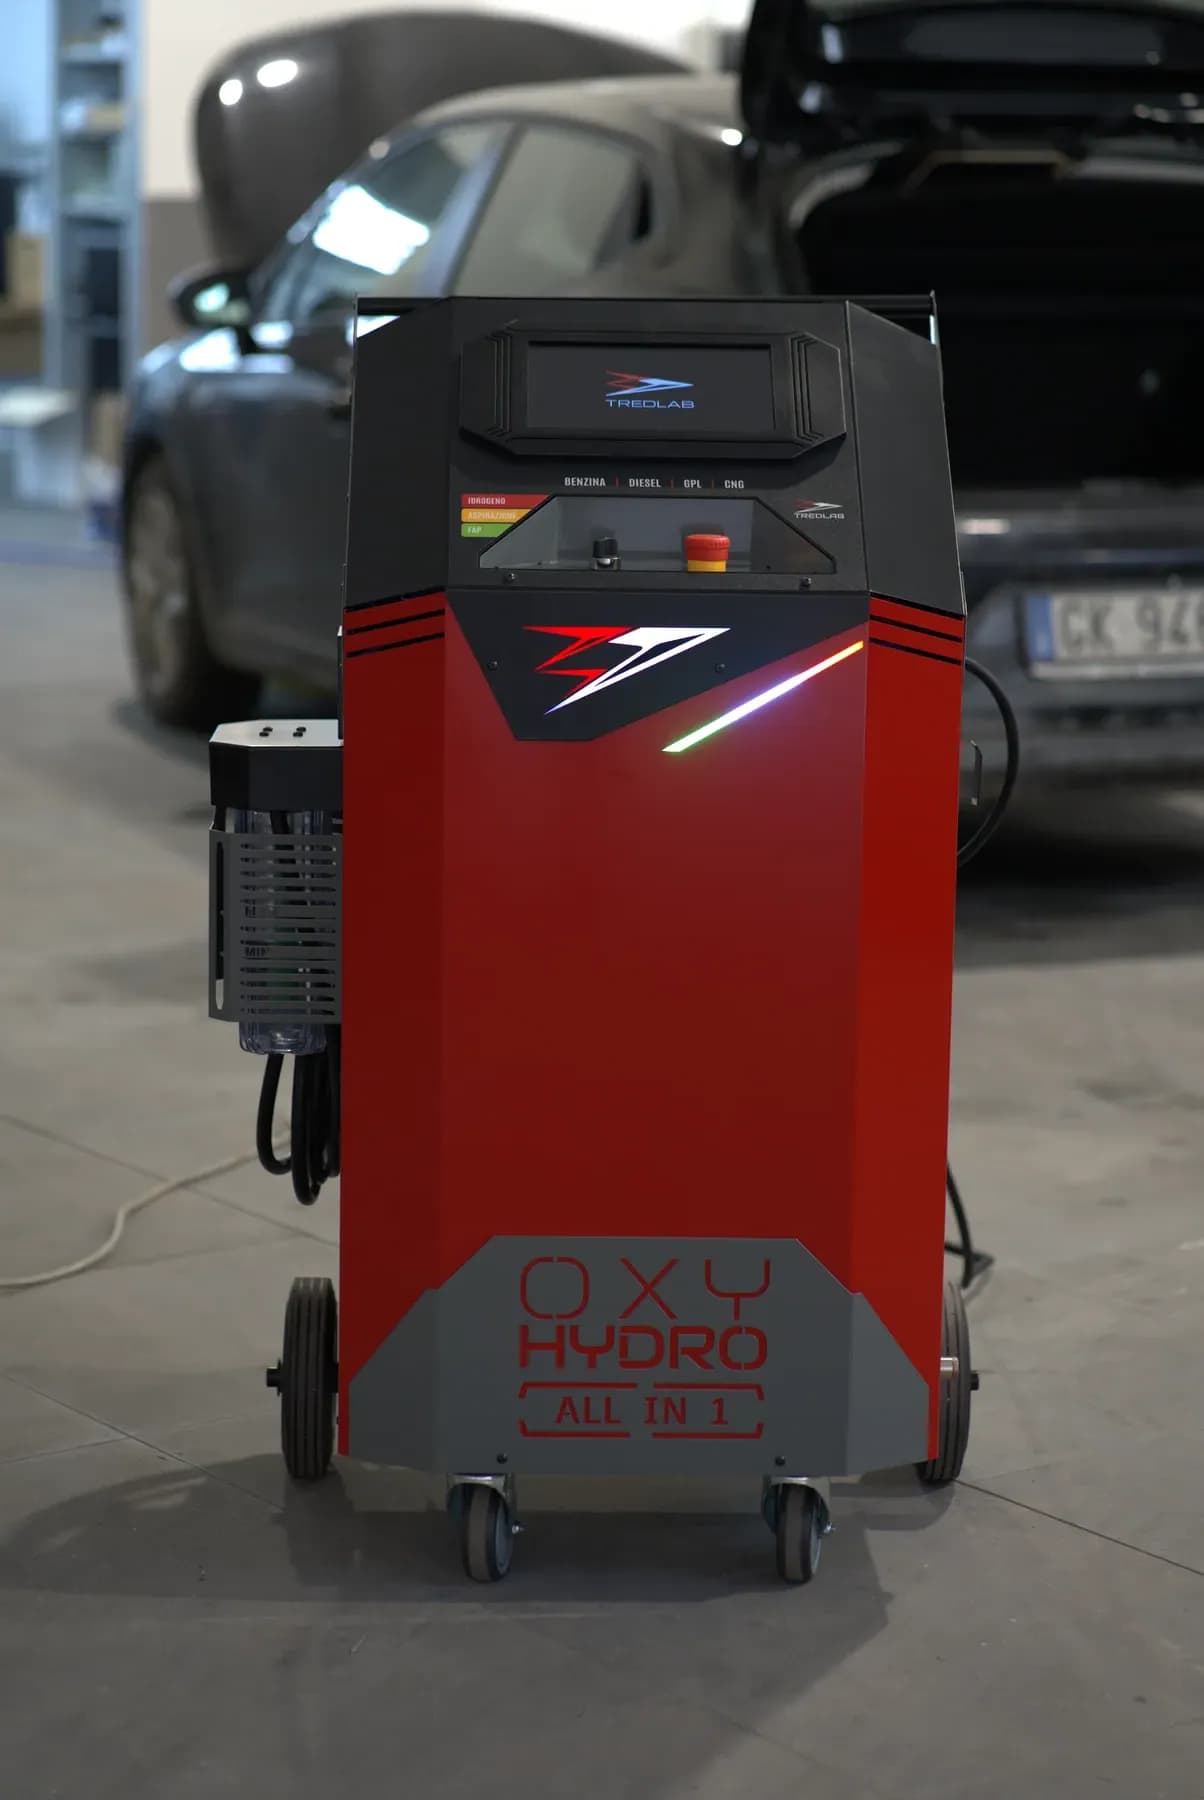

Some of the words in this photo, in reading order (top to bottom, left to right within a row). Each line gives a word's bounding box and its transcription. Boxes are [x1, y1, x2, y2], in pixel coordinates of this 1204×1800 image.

[605, 399, 695, 409] TREDLAB
[564, 476, 606, 487] BENZINA
[628, 478, 662, 488] DIESEL
[683, 479, 703, 489] GPL
[723, 479, 745, 489] CNG
[467, 496, 506, 505] IDROGENO
[793, 512, 845, 520] TREDLAB
[467, 526, 482, 534] FAP
[520, 1256, 771, 1321] OXY
[518, 1324, 768, 1370] HYDRO
[555, 1395, 622, 1425] ALL
[643, 1396, 688, 1425] IN
[711, 1397, 729, 1426] 1
